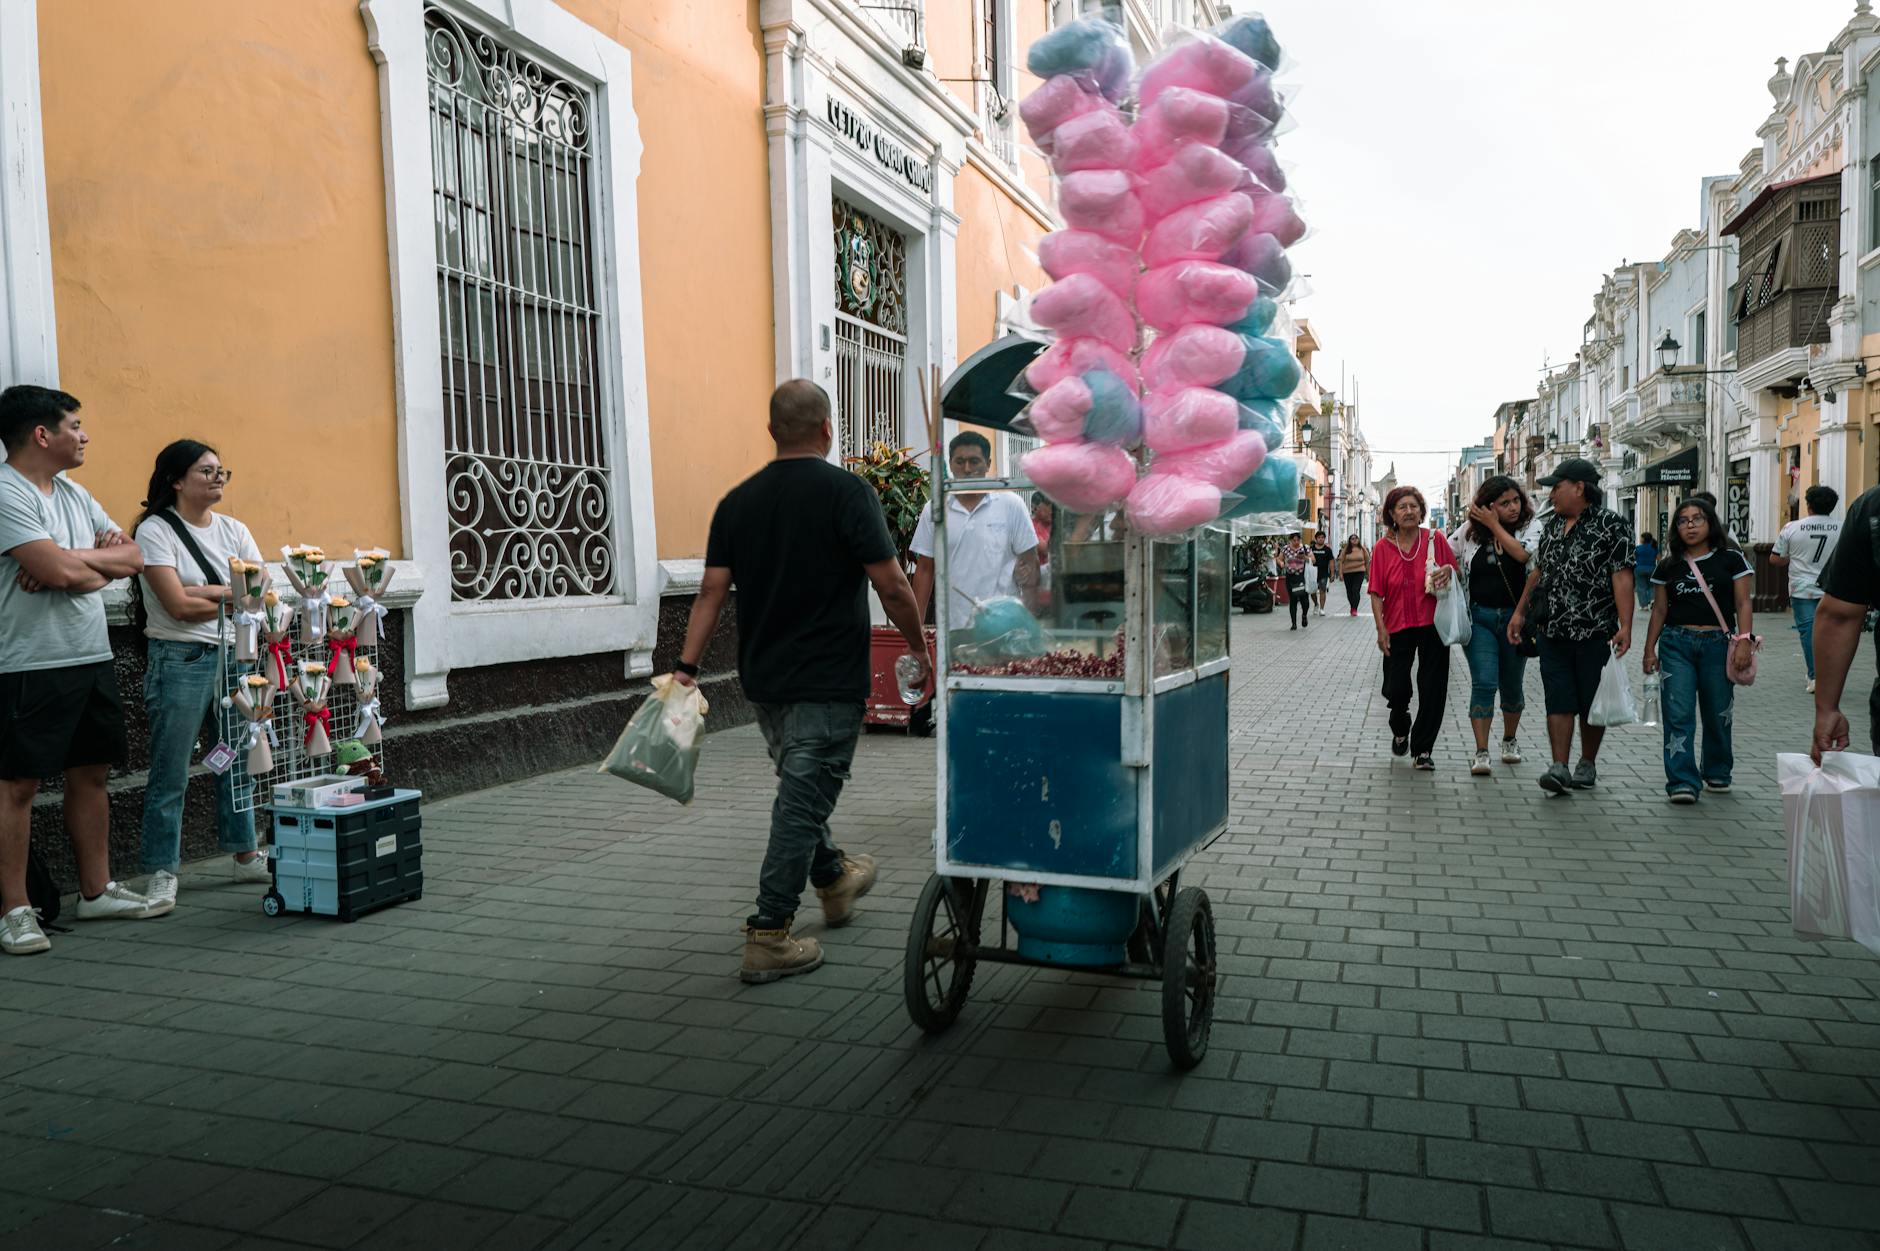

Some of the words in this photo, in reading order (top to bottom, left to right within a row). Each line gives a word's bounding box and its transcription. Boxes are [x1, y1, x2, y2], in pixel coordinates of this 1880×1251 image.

[874, 134, 904, 175] GRAN
[1800, 523, 1838, 532] RONALDO
[1810, 534, 1828, 563] 7
[1676, 582, 1714, 596] Smie
